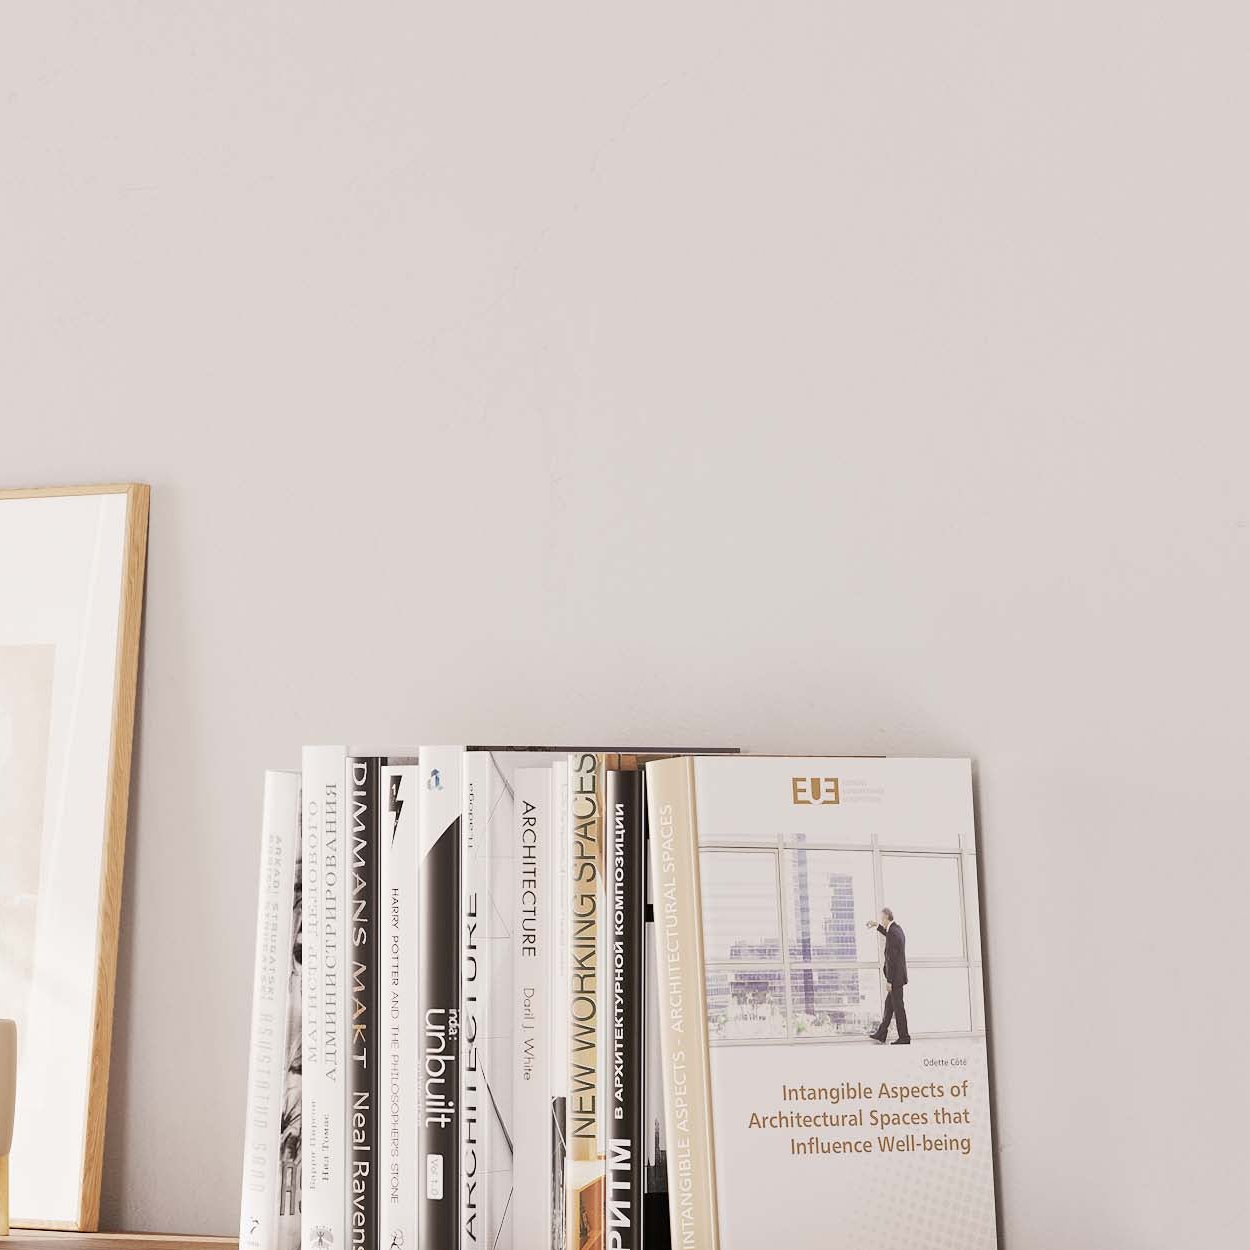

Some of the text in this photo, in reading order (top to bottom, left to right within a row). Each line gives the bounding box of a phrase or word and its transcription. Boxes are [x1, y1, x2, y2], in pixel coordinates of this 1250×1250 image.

[659, 804, 675, 873] SPACES
[793, 777, 839, 804] EUE
[307, 800, 319, 1065] МАГИСТР ДЕЛОВОГО
[324, 782, 338, 1083] АДМИНИСТРИРОВАНИЯ
[351, 761, 368, 1068] DIMMANS MAKT
[520, 800, 536, 957] ARCHITECTURE
[572, 754, 597, 1139] NEW WORKING SPACES
[613, 802, 626, 1120] В АРХИТЕКТУРНОЙ КОМПОЗИЦИИ
[662, 877, 684, 1033] ARCHITECTURAL
[389, 888, 399, 1204] HARRY POTTER AND THE PHILOSOPHER'S STONE
[424, 1009, 456, 1128] unbuilt
[466, 892, 477, 1243] ARCHITECTURE
[521, 987, 535, 1081] Daril J. White
[923, 1058, 948, 1067] Odette
[352, 1091, 370, 1152] Neal
[671, 1051, 689, 1133] ASPECTS
[748, 1108, 971, 1130] Architectural Spaces that
[782, 1080, 969, 1104] Intangible Aspects of
[791, 1134, 972, 1155] Influence Well-being
[677, 1138, 695, 1250] INTANGIBLE
